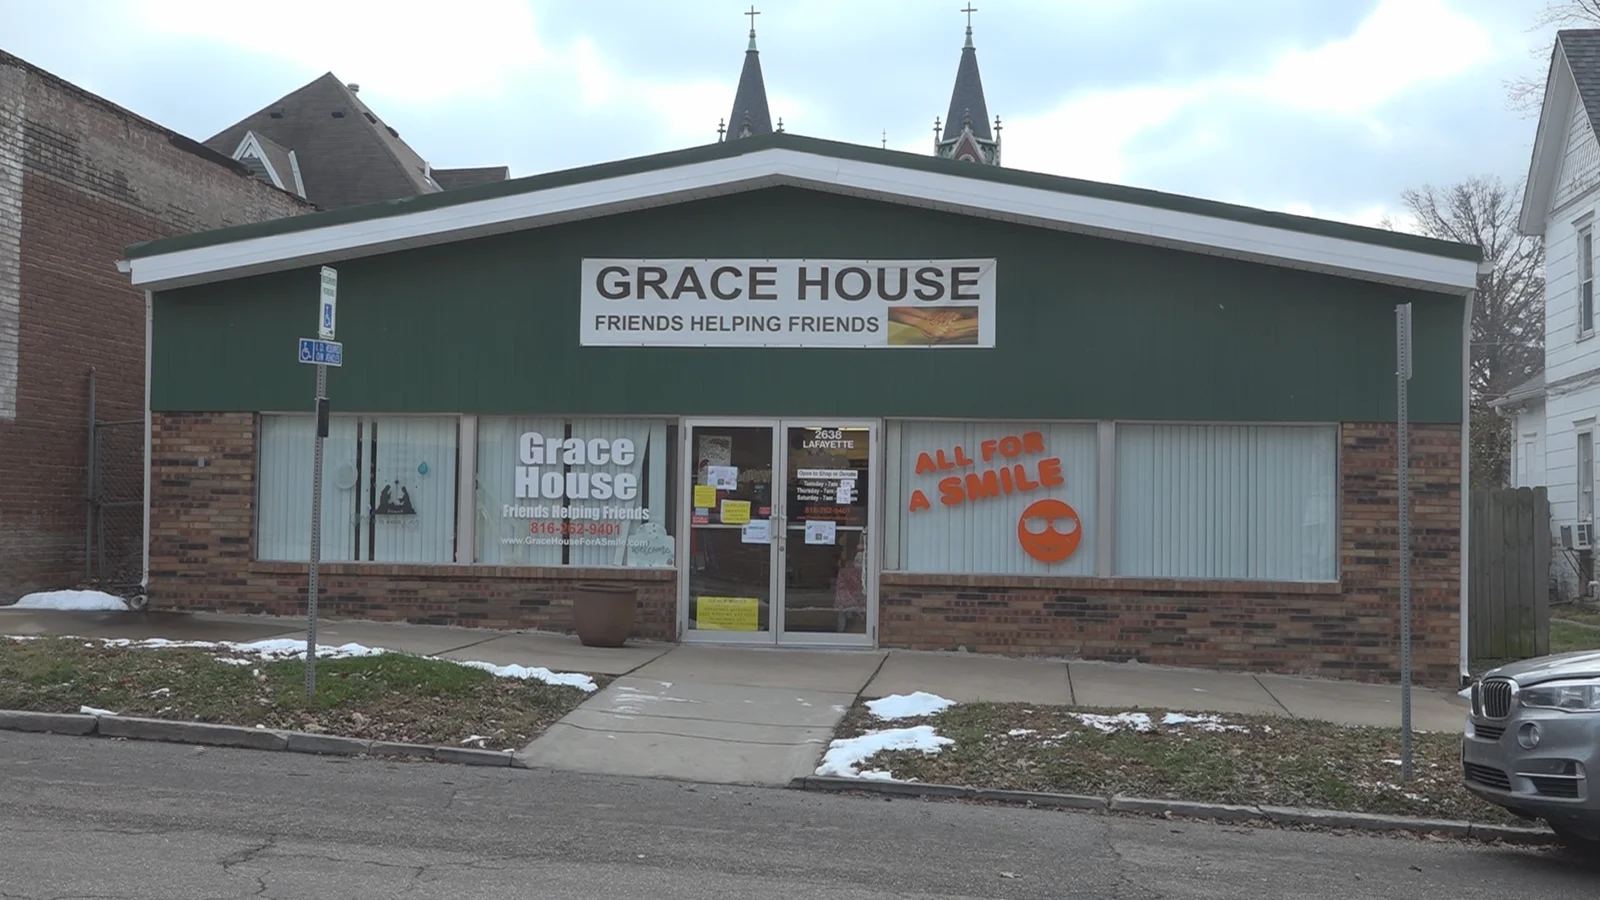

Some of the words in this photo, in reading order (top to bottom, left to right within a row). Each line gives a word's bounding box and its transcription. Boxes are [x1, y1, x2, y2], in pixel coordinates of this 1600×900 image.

[596, 266, 778, 301] GRACE
[799, 266, 980, 301] HOUSE
[595, 315, 683, 332] FRIENDS
[691, 315, 781, 332] HELPING
[789, 316, 879, 333] FRIENDS
[815, 430, 842, 440] 2638
[519, 431, 635, 466] Grace
[803, 440, 854, 449] LAFAYETTE
[915, 445, 974, 475] ALL
[980, 431, 1045, 462] FOR
[515, 466, 637, 500] House
[803, 480, 825, 488] Tuesday
[909, 489, 931, 513] A
[938, 457, 1065, 506] SMILE
[796, 487, 820, 495] Thursday
[797, 494, 819, 502] Saturday
[502, 504, 549, 519] Friends
[552, 505, 600, 521] Helping
[603, 505, 650, 520] Friends
[530, 522, 621, 536] 816-262-9401
[500, 536, 649, 548] www.GraceHouseForASmile.com
